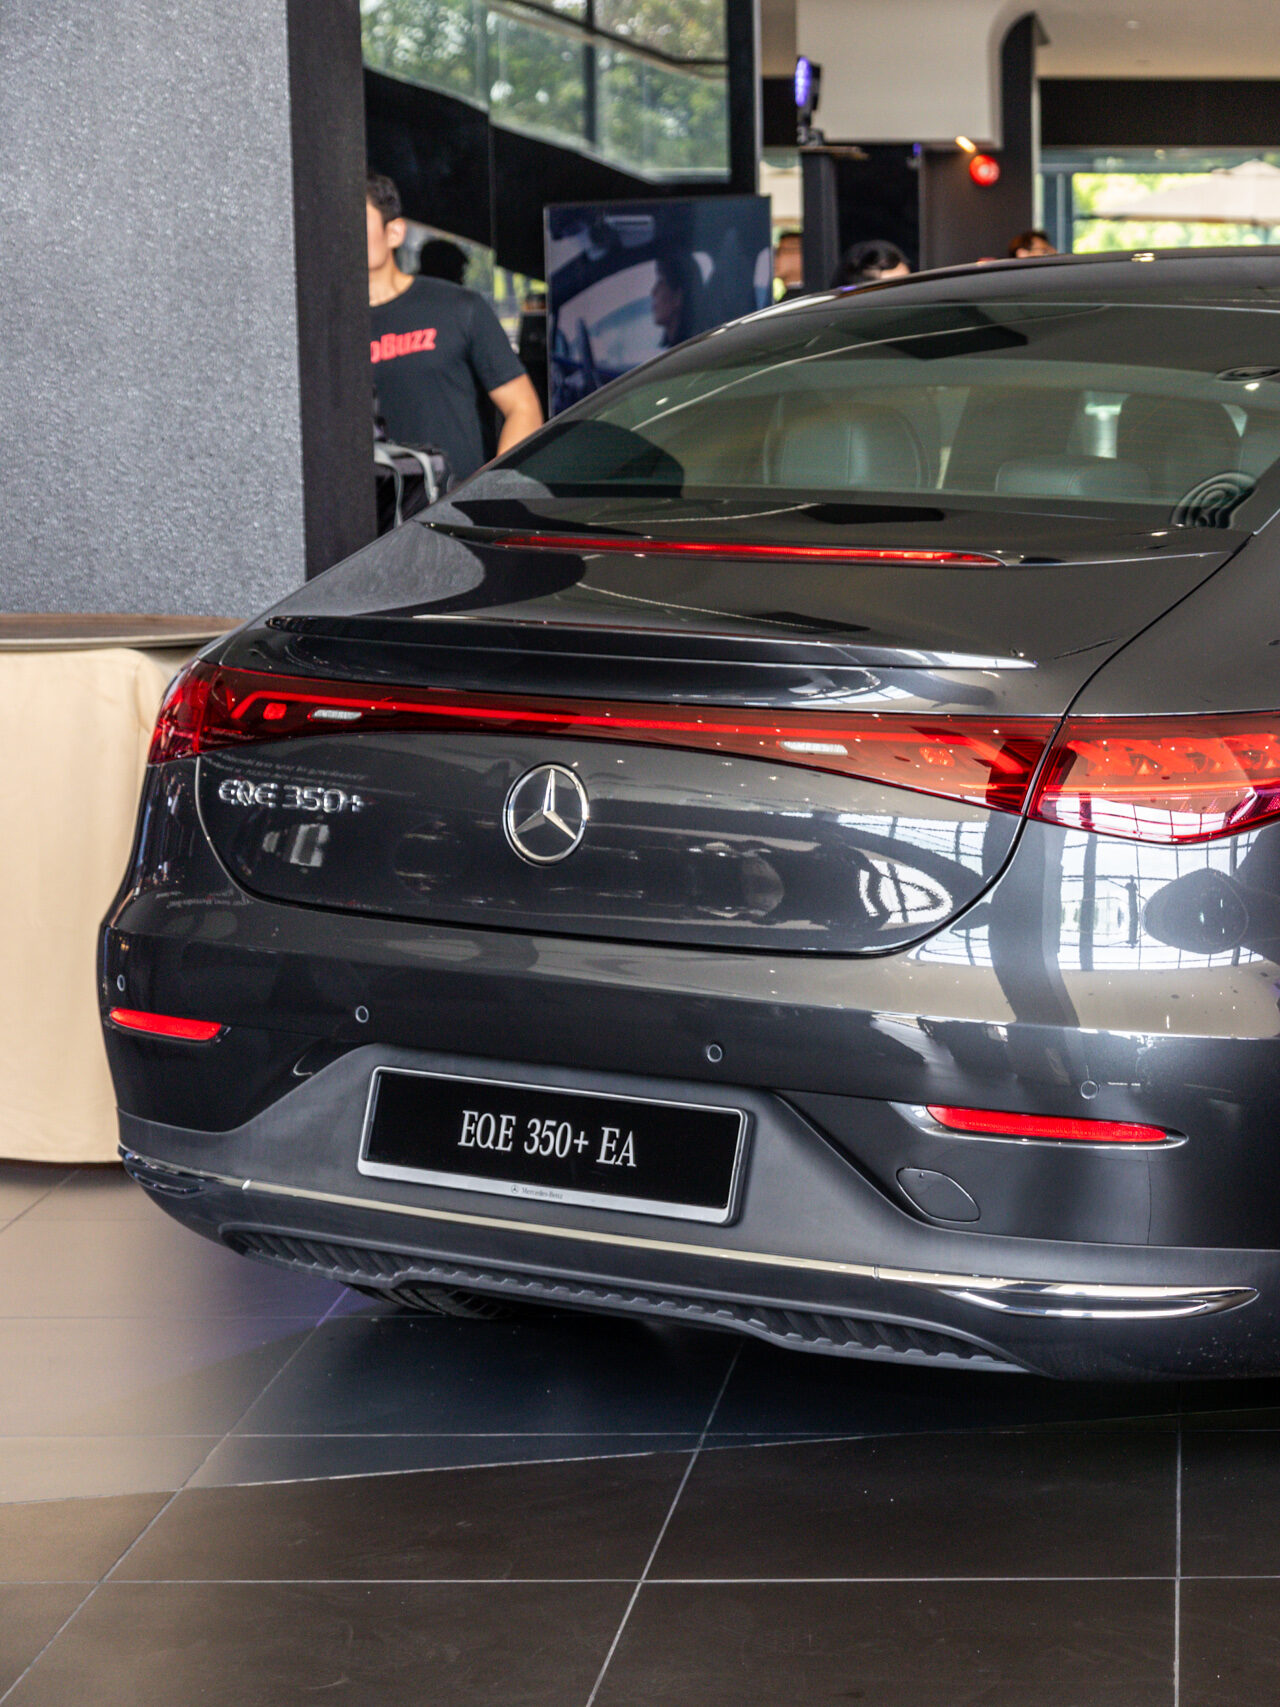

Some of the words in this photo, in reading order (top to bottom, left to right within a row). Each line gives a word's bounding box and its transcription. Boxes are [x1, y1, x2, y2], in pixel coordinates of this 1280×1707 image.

[218, 779, 278, 807] EQE
[281, 783, 365, 813] 350+
[457, 1110, 516, 1151] EQE
[523, 1118, 589, 1158] 350+
[596, 1126, 637, 1168] EA
[522, 1187, 563, 1199] Mercedes-Benz
